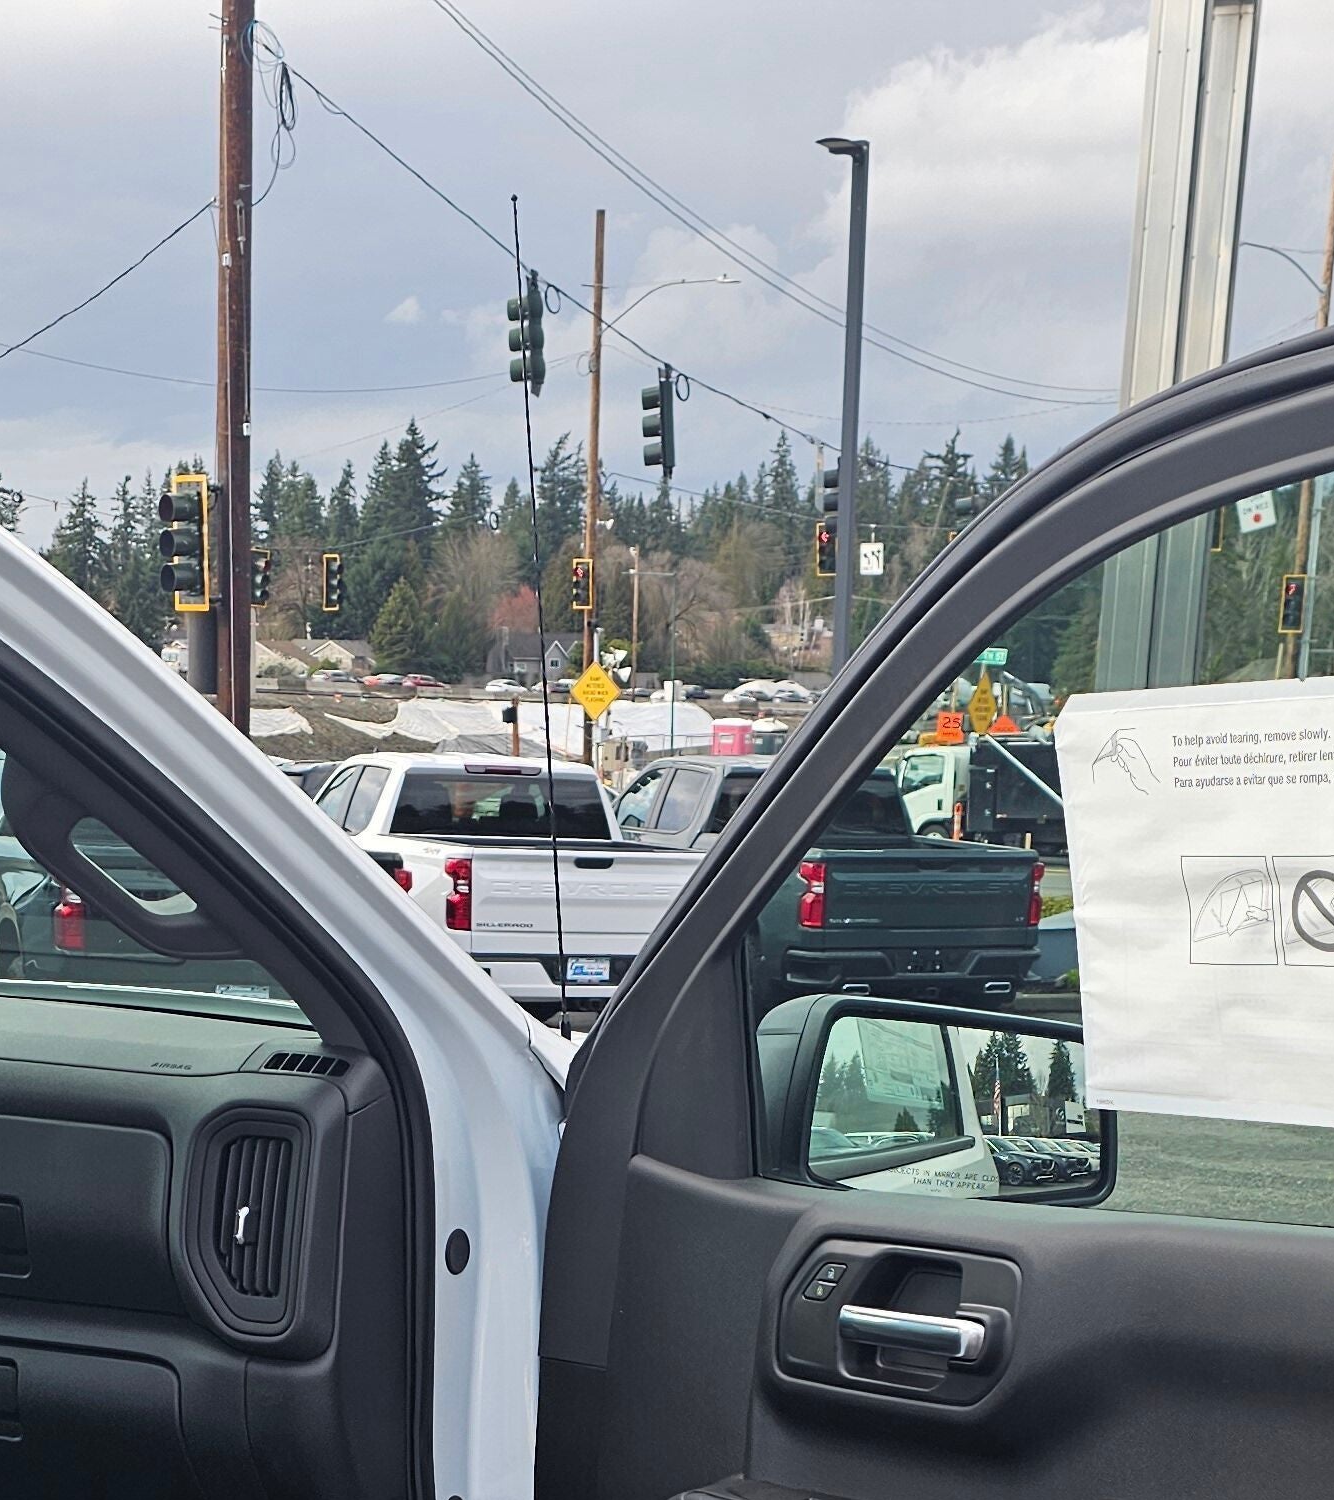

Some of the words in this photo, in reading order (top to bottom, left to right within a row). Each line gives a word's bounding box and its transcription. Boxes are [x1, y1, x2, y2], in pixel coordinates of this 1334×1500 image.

[942, 716, 961, 729] 25
[1172, 735, 1183, 747] To
[1184, 734, 1204, 748] help
[1205, 732, 1228, 745] avoid
[1229, 731, 1262, 745] tearing,
[1264, 730, 1297, 742] remove
[1299, 727, 1331, 742] slowly.
[1173, 756, 1192, 767] Pour
[1195, 754, 1218, 767] éviter
[1220, 753, 1242, 765] toute
[1243, 752, 1287, 765] déchirure,
[1289, 750, 1317, 763] retirer
[1174, 777, 1193, 788] Para
[1195, 775, 1234, 790] ayudarse
[1236, 778, 1242, 786] a
[1243, 773, 1266, 785] evitar
[1267, 774, 1284, 788] que
[1286, 773, 1297, 784] se
[1299, 773, 1332, 786] rompa,
[490, 881, 684, 897] CHEVROLE
[150, 1062, 193, 1070] AIRBAG
[934, 1170, 961, 1180] MIRROR
[913, 1177, 932, 1185] THAN
[936, 1179, 954, 1188] THEY
[956, 1180, 987, 1190] APPEAR
